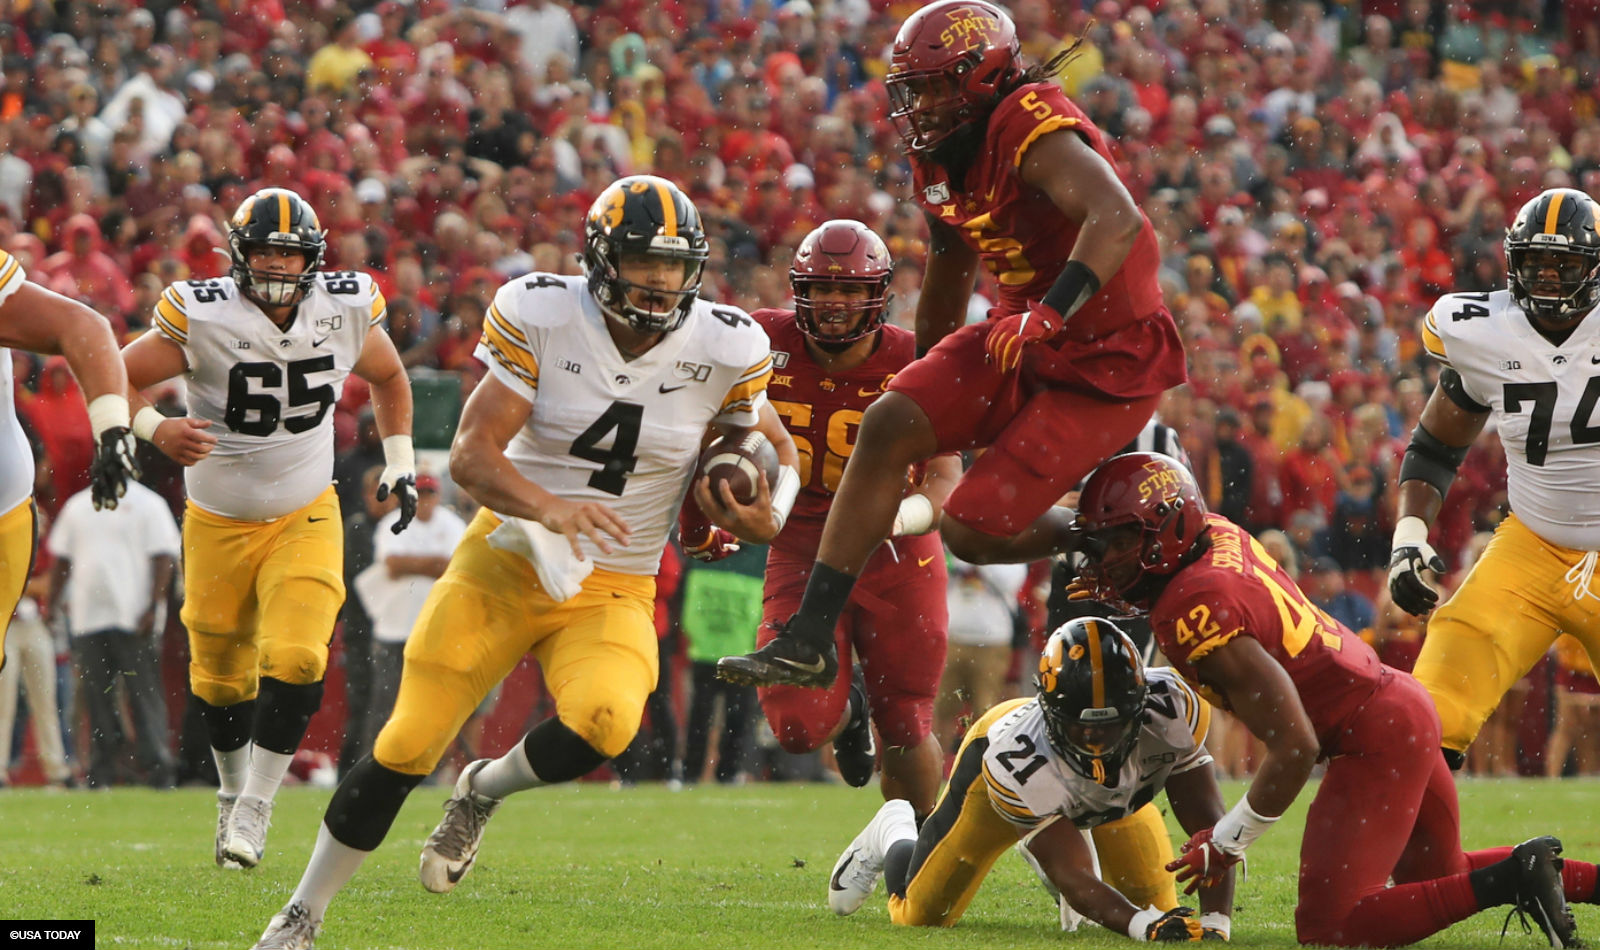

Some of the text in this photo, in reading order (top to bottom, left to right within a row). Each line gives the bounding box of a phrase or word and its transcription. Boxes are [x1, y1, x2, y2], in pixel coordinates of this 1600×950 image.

[941, 16, 1000, 48] STATE
[1020, 91, 1052, 120] 5
[961, 212, 1036, 285] 5
[525, 275, 568, 291] 4
[711, 308, 751, 328] 4
[1452, 292, 1490, 322] 74
[224, 354, 336, 437] 65
[1503, 376, 1600, 467] 74
[569, 400, 644, 497] 4
[1138, 469, 1192, 499] STATE
[1176, 604, 1221, 646] 42
[996, 734, 1048, 786] 21
